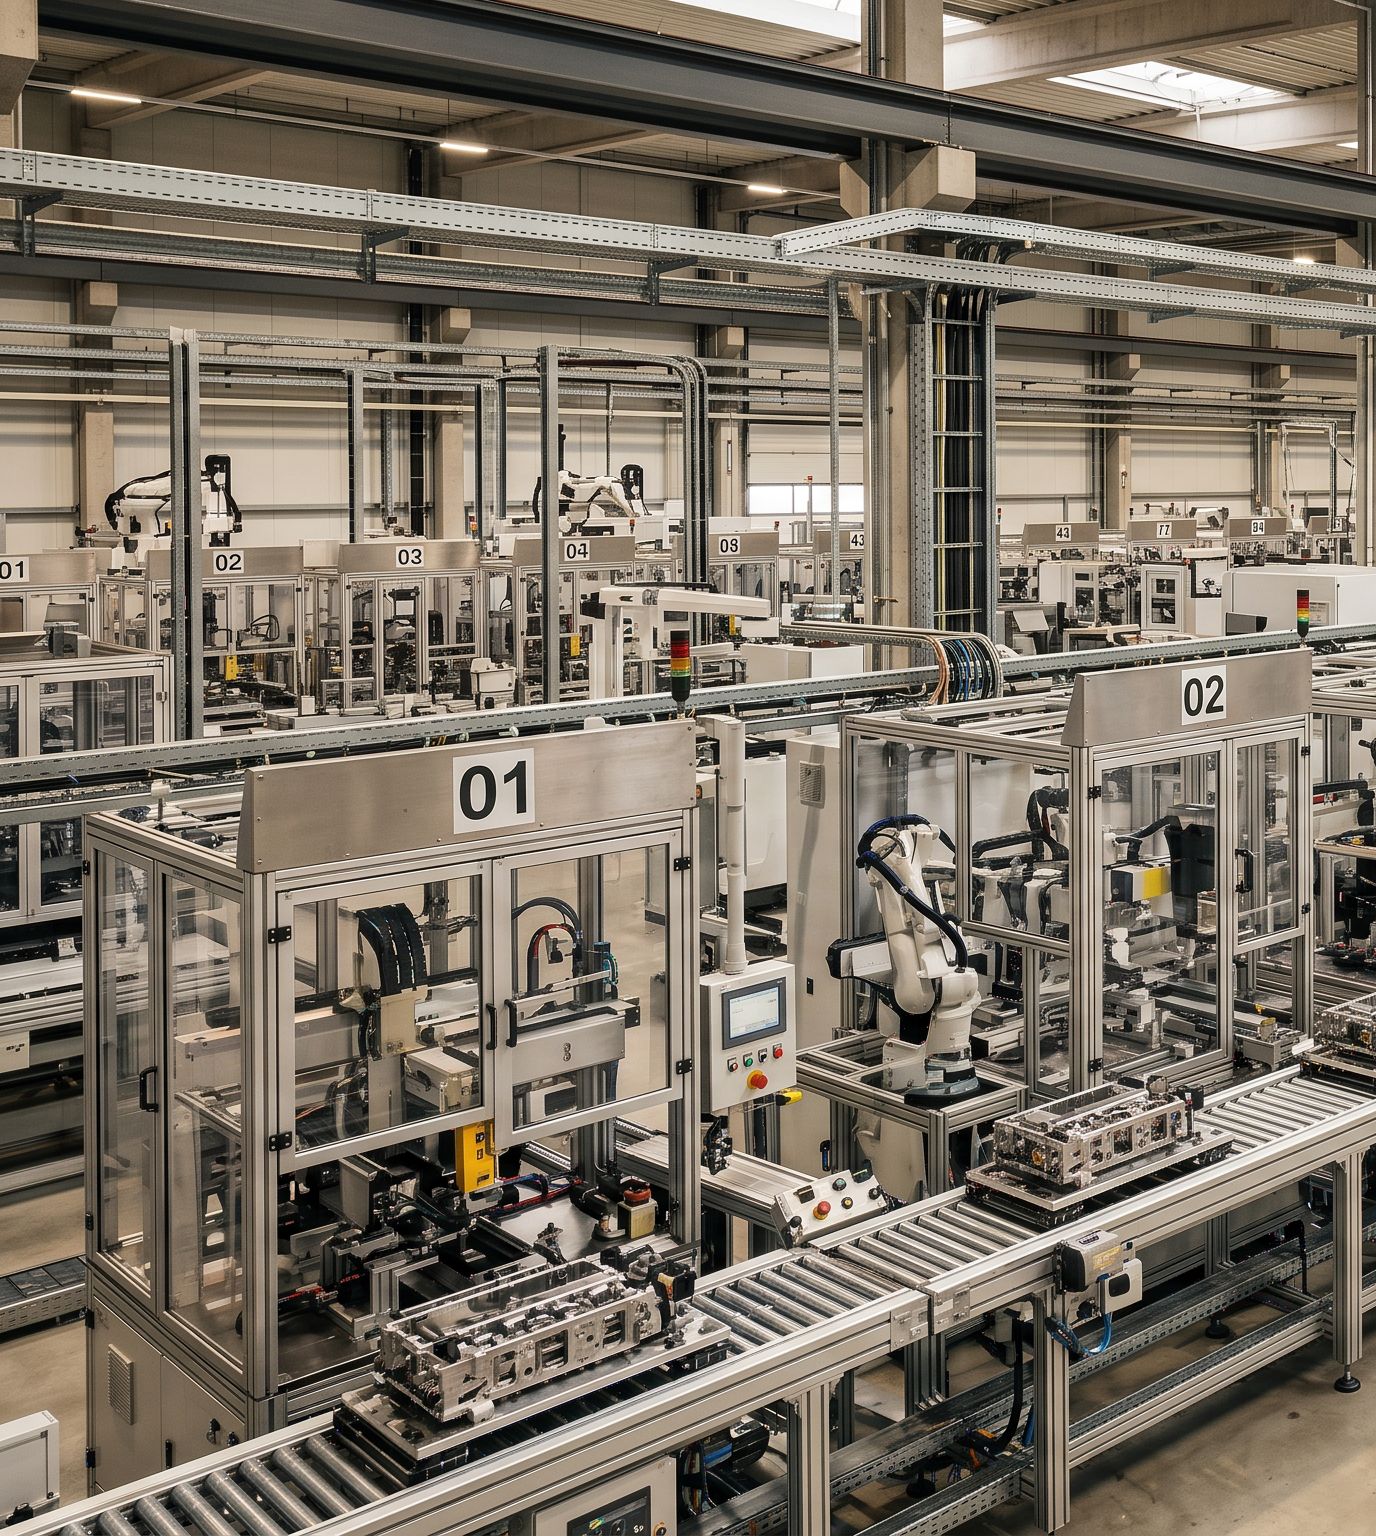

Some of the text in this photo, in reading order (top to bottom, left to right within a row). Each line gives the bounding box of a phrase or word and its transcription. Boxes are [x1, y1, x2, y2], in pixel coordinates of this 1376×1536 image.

[215, 553, 242, 571] 02
[398, 548, 422, 565] 03
[0, 560, 24, 579] 01
[1184, 674, 1224, 717] 02
[459, 760, 527, 821] 01
